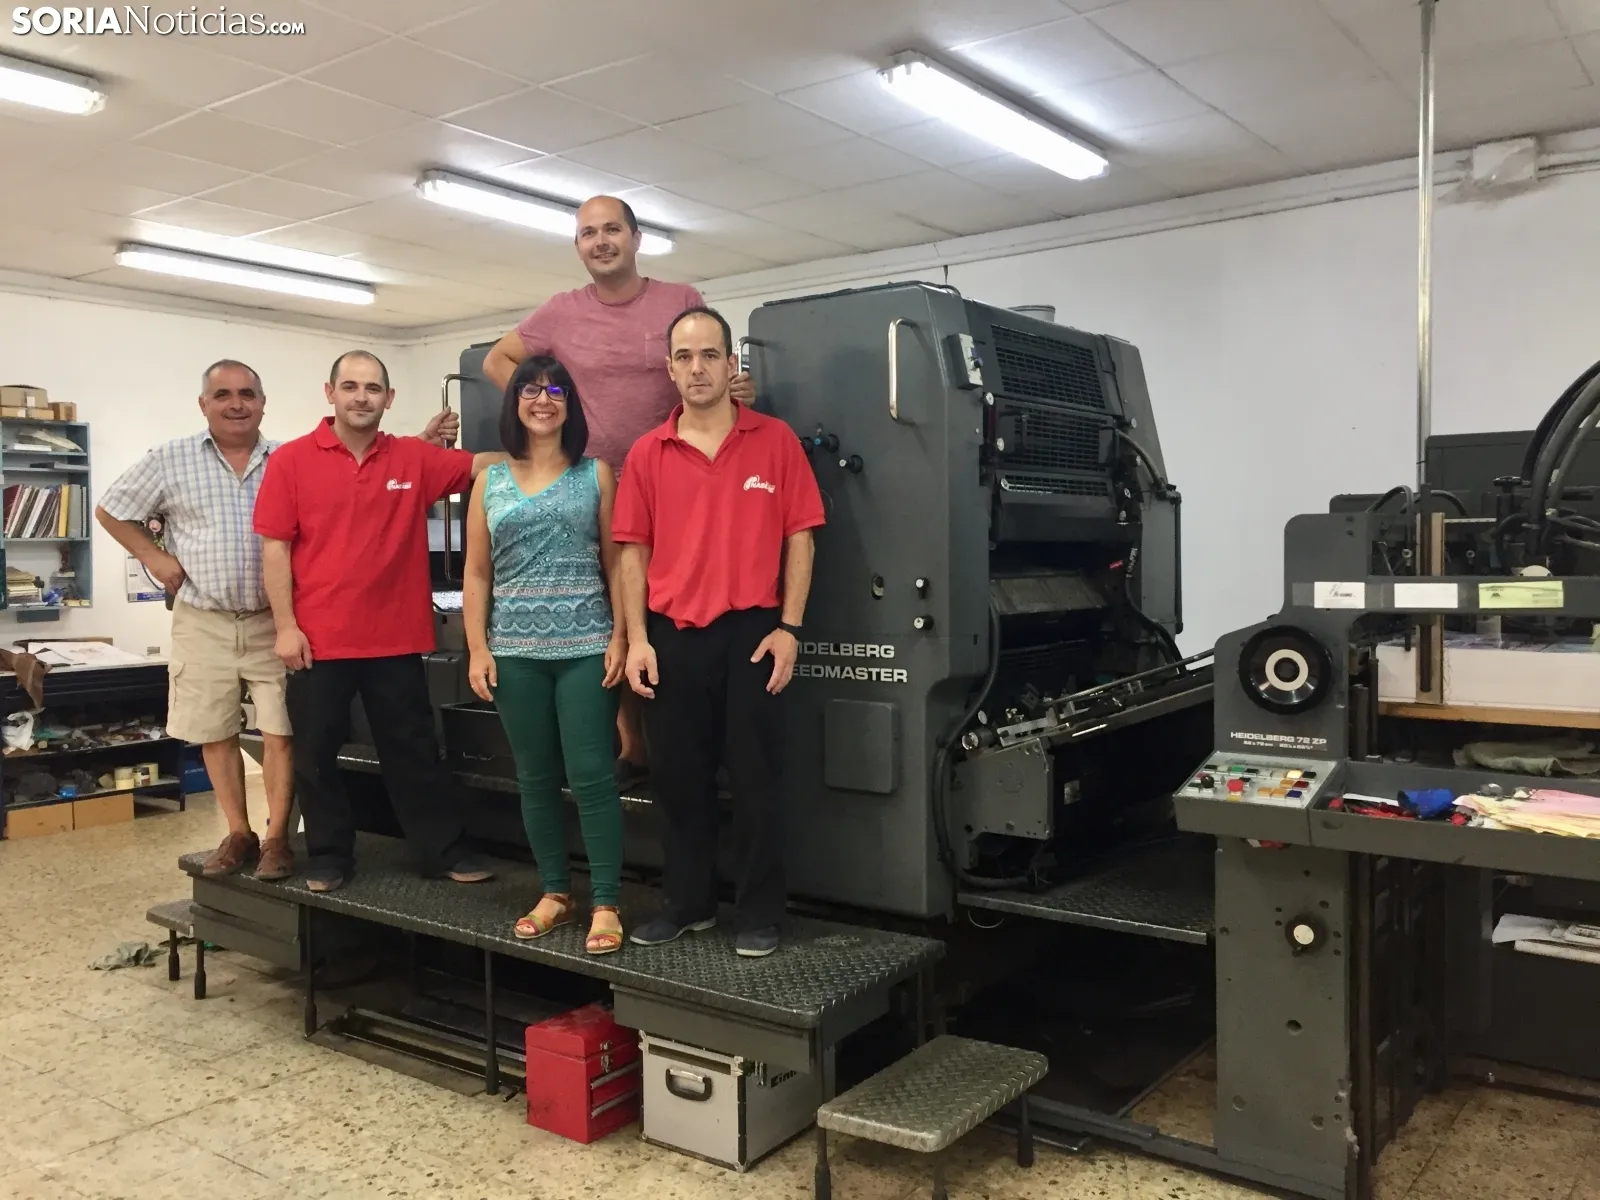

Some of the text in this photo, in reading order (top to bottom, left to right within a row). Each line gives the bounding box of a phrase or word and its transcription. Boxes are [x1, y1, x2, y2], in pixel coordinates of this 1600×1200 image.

[798, 641, 895, 659] IDELBERG
[792, 663, 908, 683] EEDMASTER
[1230, 731, 1295, 743] HEIDELBERG
[1311, 737, 1327, 745] ZP
